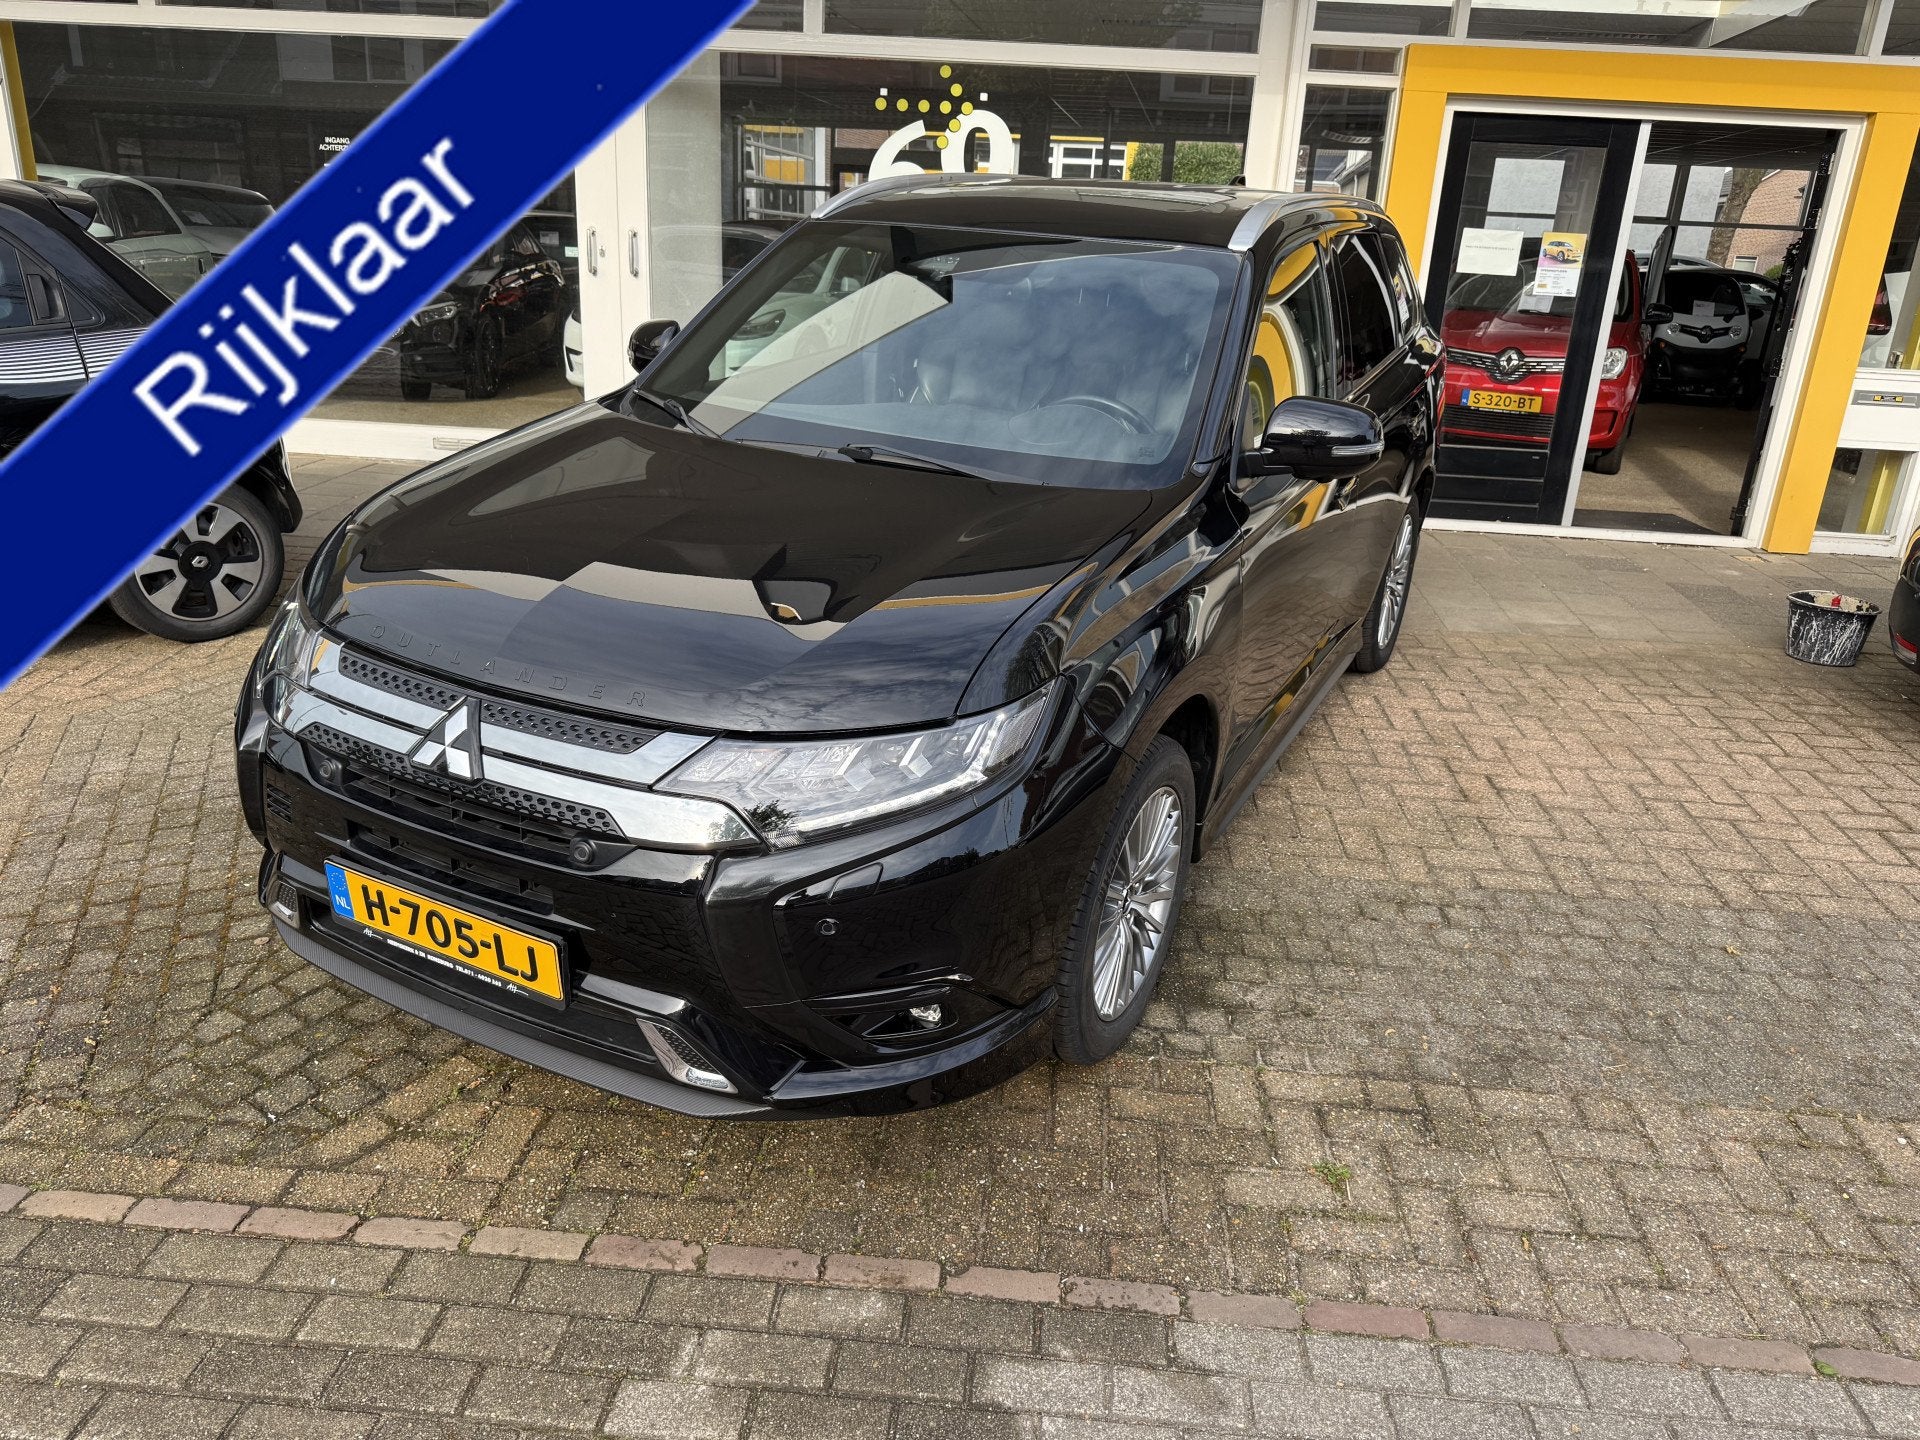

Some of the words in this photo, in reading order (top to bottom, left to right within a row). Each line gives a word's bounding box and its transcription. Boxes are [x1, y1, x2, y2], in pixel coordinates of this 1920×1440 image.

[324, 136, 350, 144] INGANG
[1472, 392, 1536, 410] S-320-BT
[369, 624, 646, 708] OUTLANDER
[335, 894, 351, 910] NL
[361, 884, 539, 983] H-705-LJ
